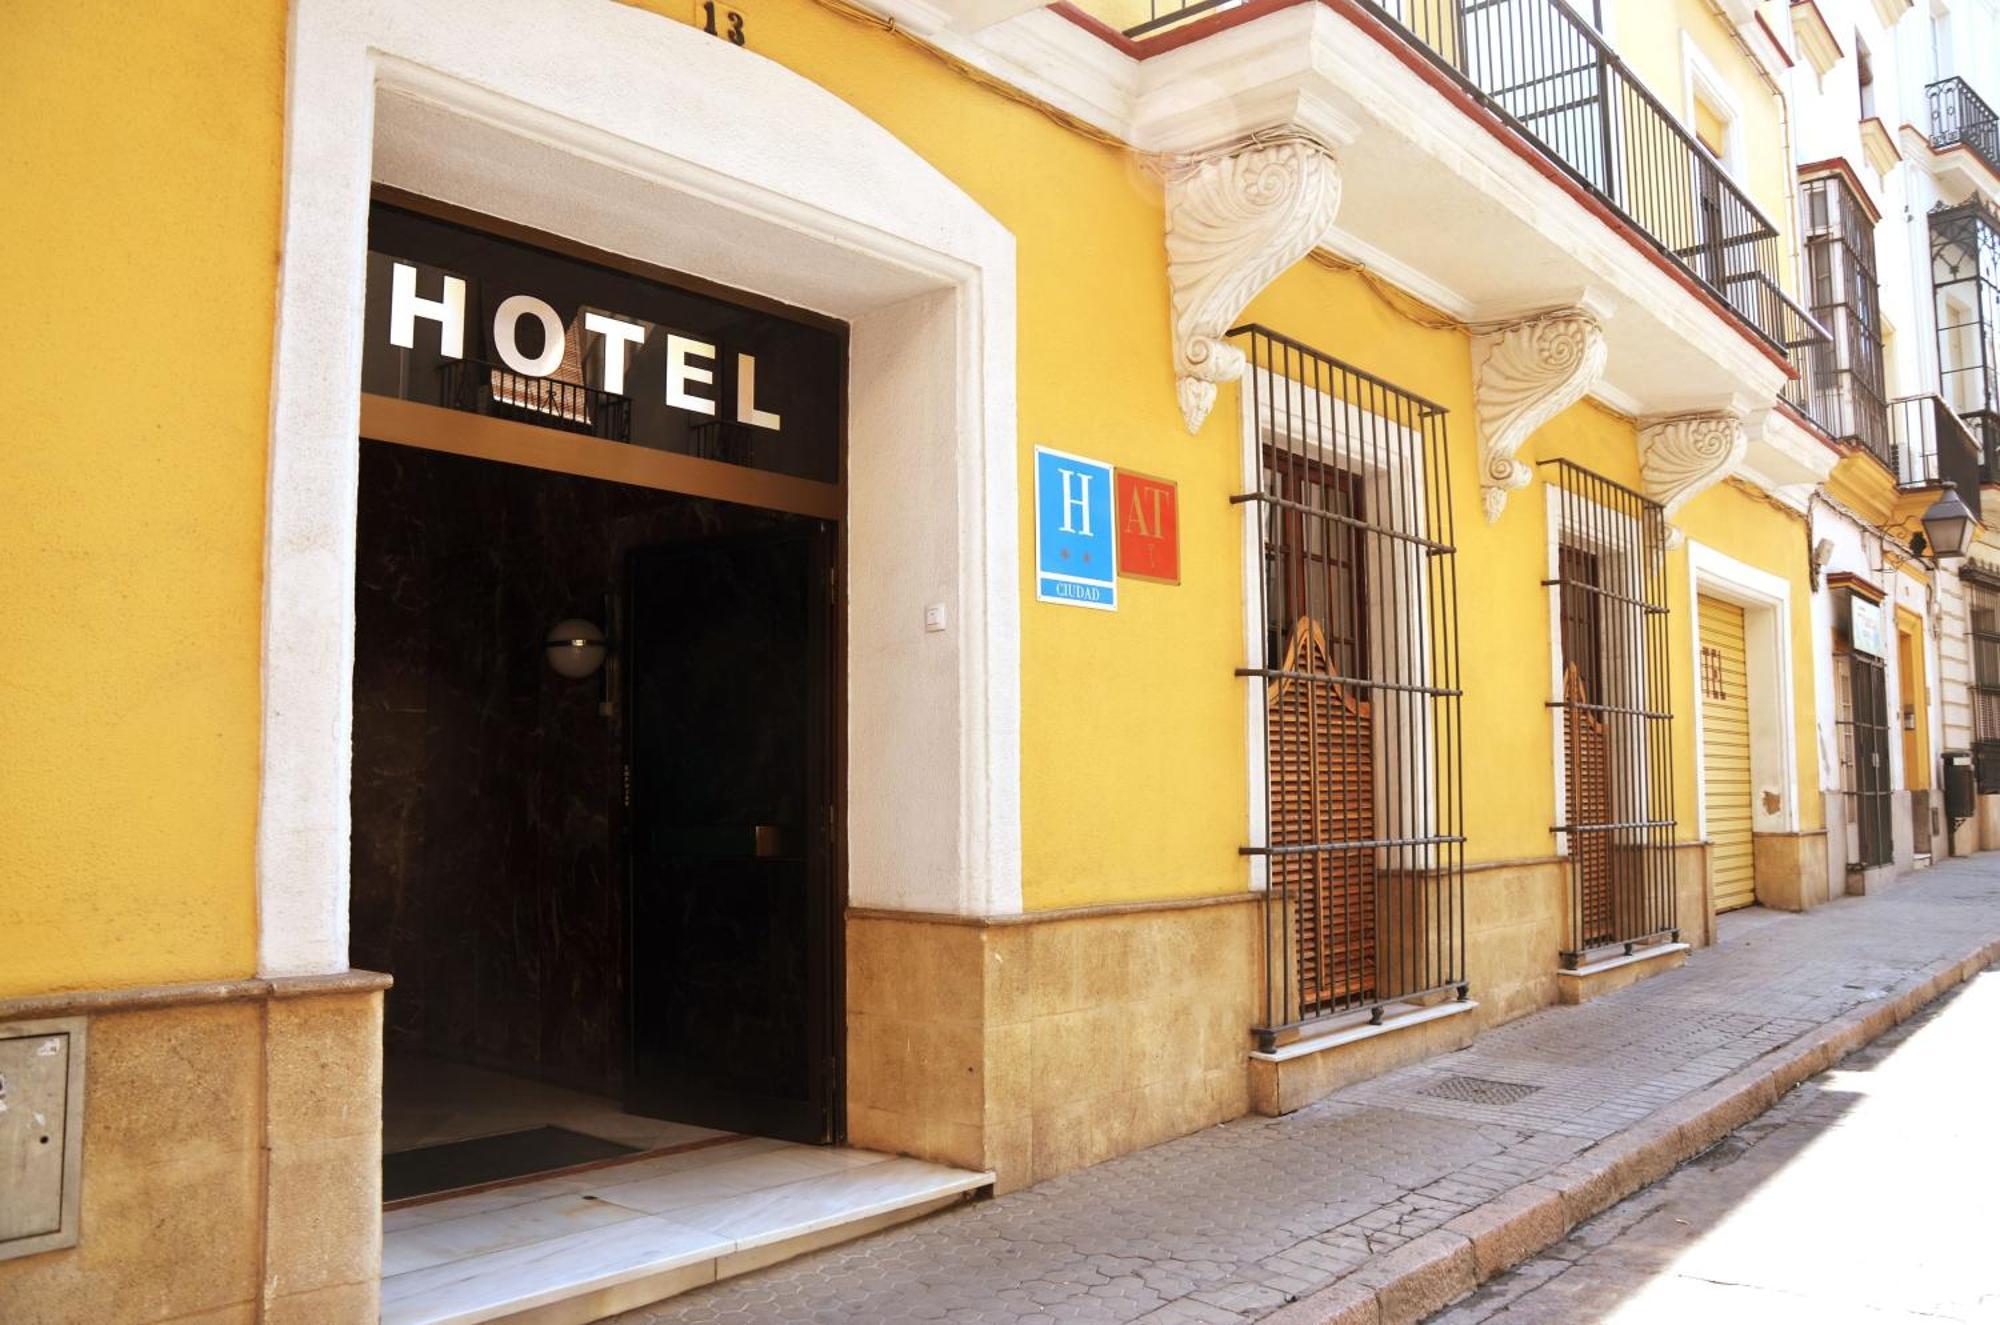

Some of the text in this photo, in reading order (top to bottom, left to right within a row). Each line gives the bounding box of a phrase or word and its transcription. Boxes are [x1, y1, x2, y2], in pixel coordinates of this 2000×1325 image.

[704, 1, 745, 46] 13
[389, 262, 781, 431] HOTEL
[1057, 468, 1094, 537] H
[1124, 485, 1170, 540] AT
[1056, 582, 1100, 601] CIUDAD
